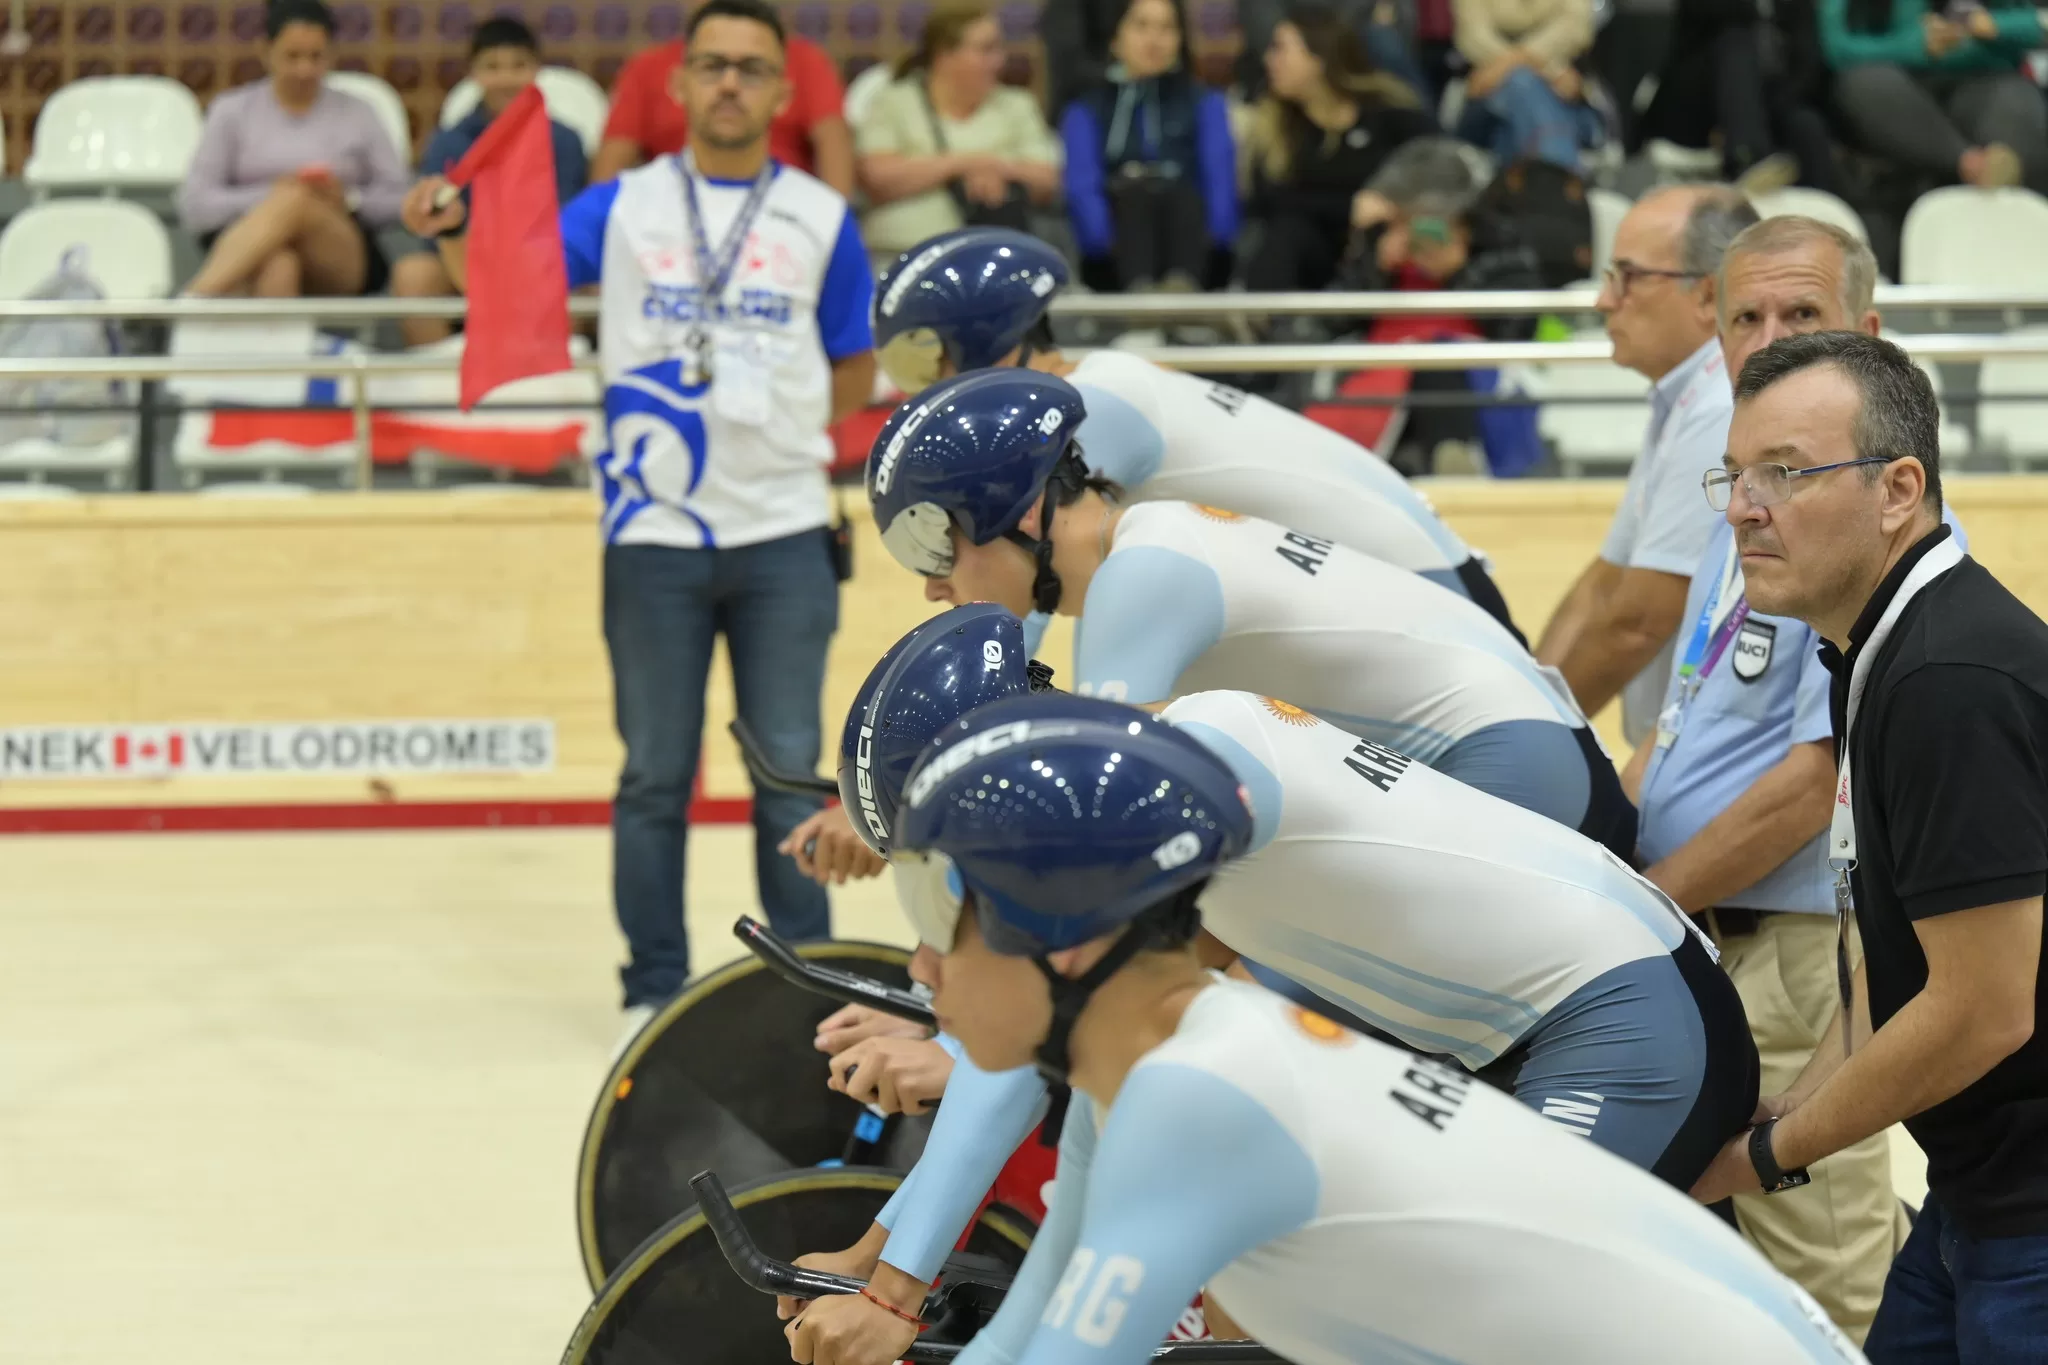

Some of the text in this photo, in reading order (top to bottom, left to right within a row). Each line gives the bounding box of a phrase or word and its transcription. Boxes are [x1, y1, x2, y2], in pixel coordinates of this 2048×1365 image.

[1039, 407, 1064, 436] 10
[875, 404, 929, 496] DIECI
[983, 639, 1003, 672] 10
[3, 724, 547, 770] NEK VELODROMES
[856, 725, 890, 840] DIECI
